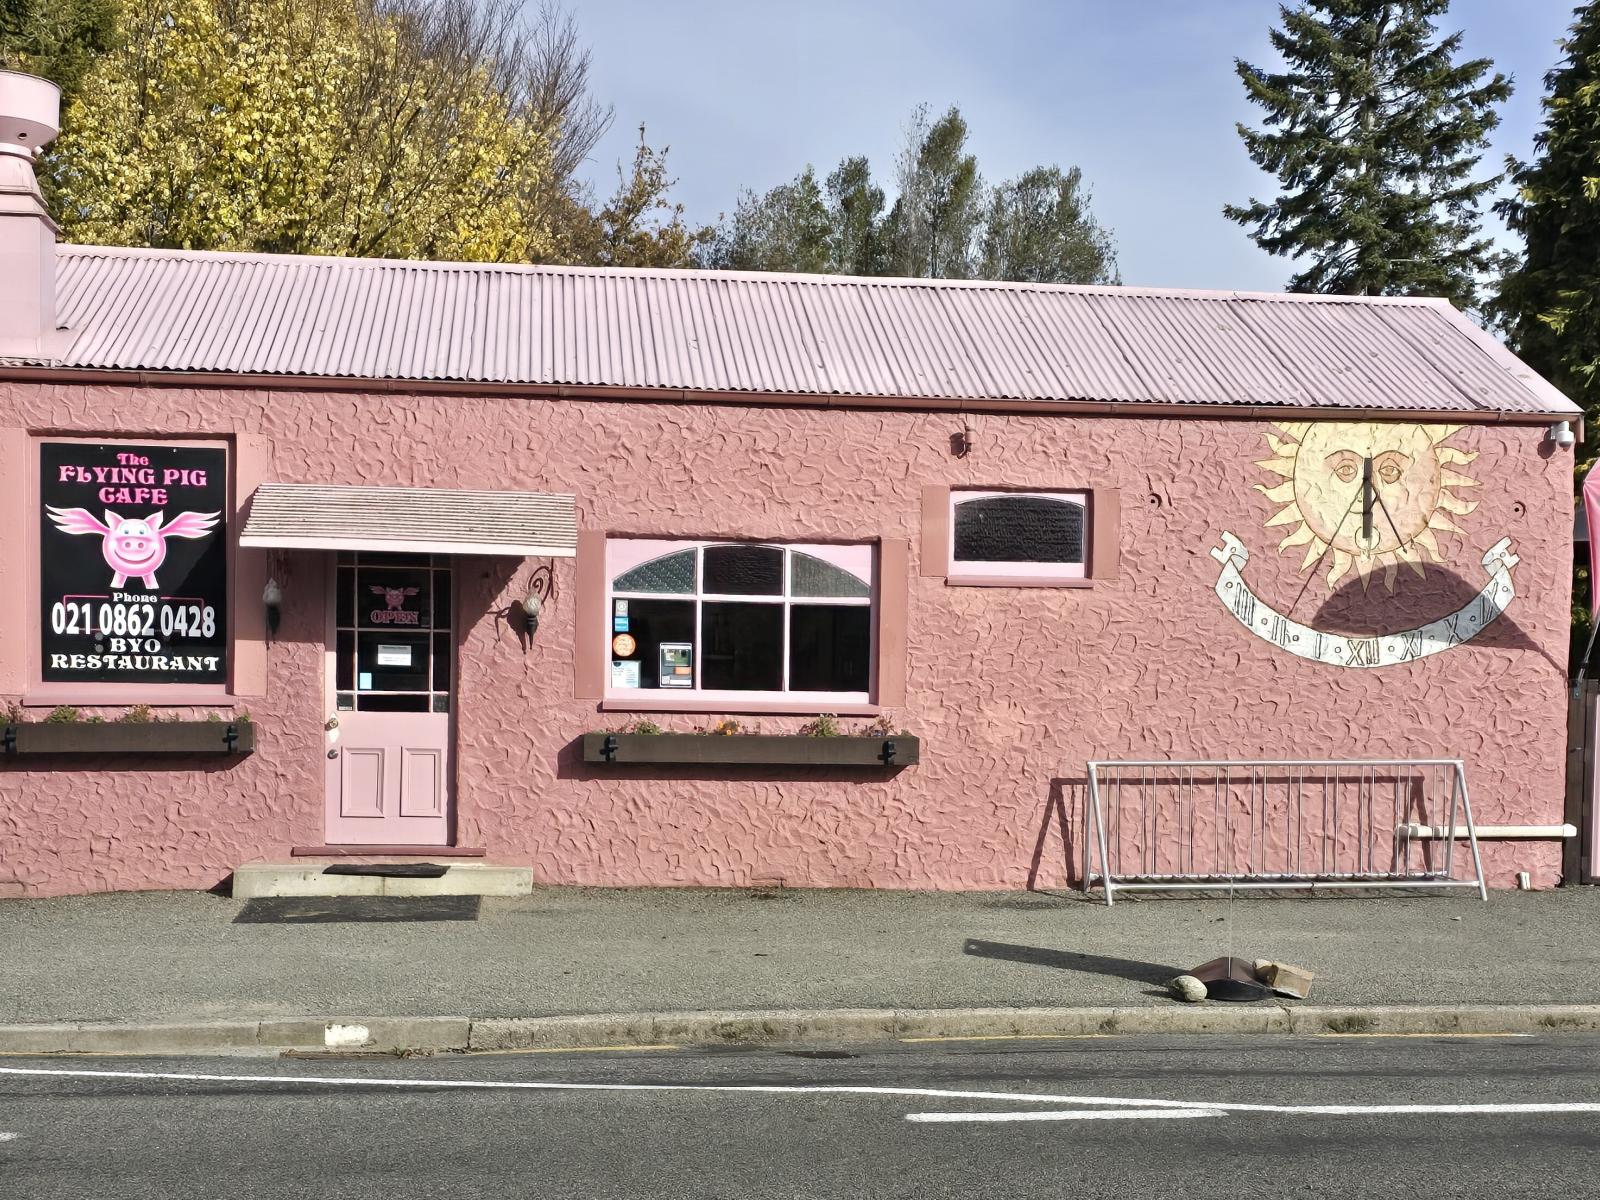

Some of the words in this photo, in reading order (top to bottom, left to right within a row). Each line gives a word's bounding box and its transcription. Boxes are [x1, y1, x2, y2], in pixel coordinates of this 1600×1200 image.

[116, 453, 149, 466] The
[59, 465, 154, 484] FLYING
[163, 469, 207, 486] PIG
[98, 487, 168, 505] CAFE
[113, 592, 158, 603] Phone
[52, 602, 91, 635] 021
[99, 603, 155, 636] 0862
[160, 605, 216, 638] 0428
[370, 610, 419, 624] OPEN
[111, 638, 161, 653] BYO
[1346, 638, 1380, 666] XII
[1400, 630, 1422, 660] XI
[1444, 613, 1465, 646] X
[51, 654, 219, 671] RESTAURANT
